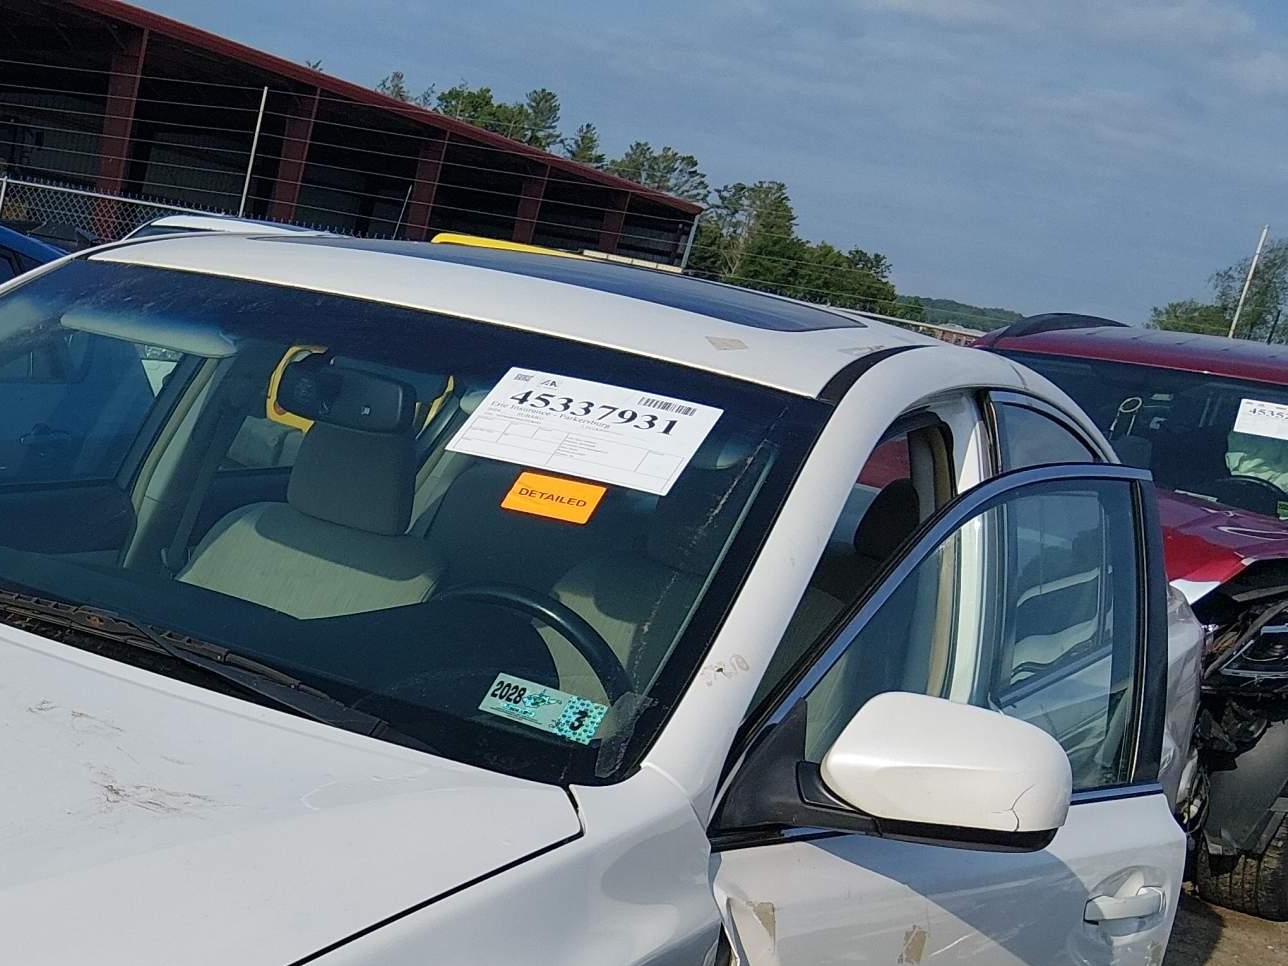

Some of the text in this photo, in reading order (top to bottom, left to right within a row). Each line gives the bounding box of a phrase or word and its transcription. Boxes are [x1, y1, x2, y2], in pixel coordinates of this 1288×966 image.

[510, 390, 681, 436] 45337931
[517, 486, 588, 509] DETAILED
[490, 680, 527, 705] 2028
[569, 709, 590, 732] 3
